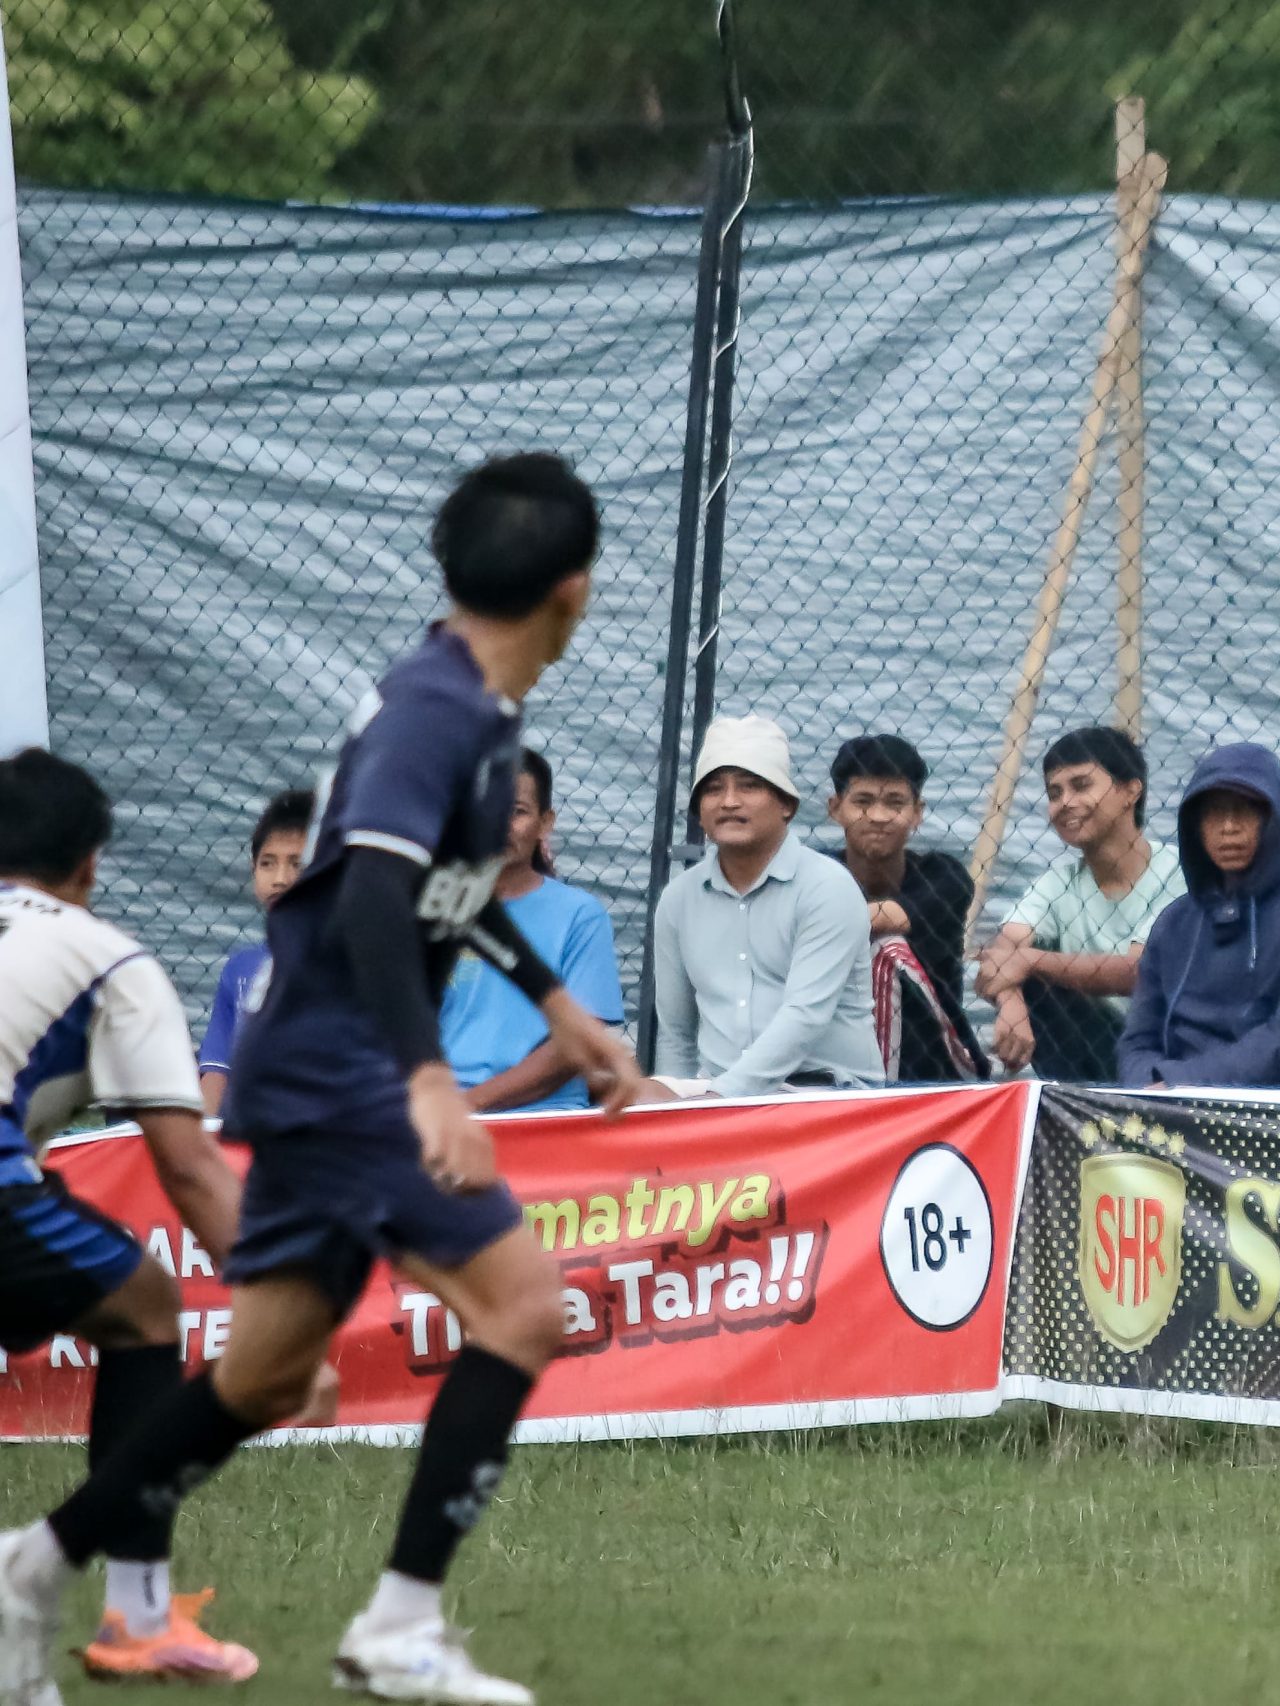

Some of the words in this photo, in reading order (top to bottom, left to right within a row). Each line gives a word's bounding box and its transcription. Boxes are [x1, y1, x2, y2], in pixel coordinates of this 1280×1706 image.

[609, 1232, 814, 1326] Tara!!
[904, 1202, 972, 1272] 18+
[1094, 1194, 1167, 1308] SHR
